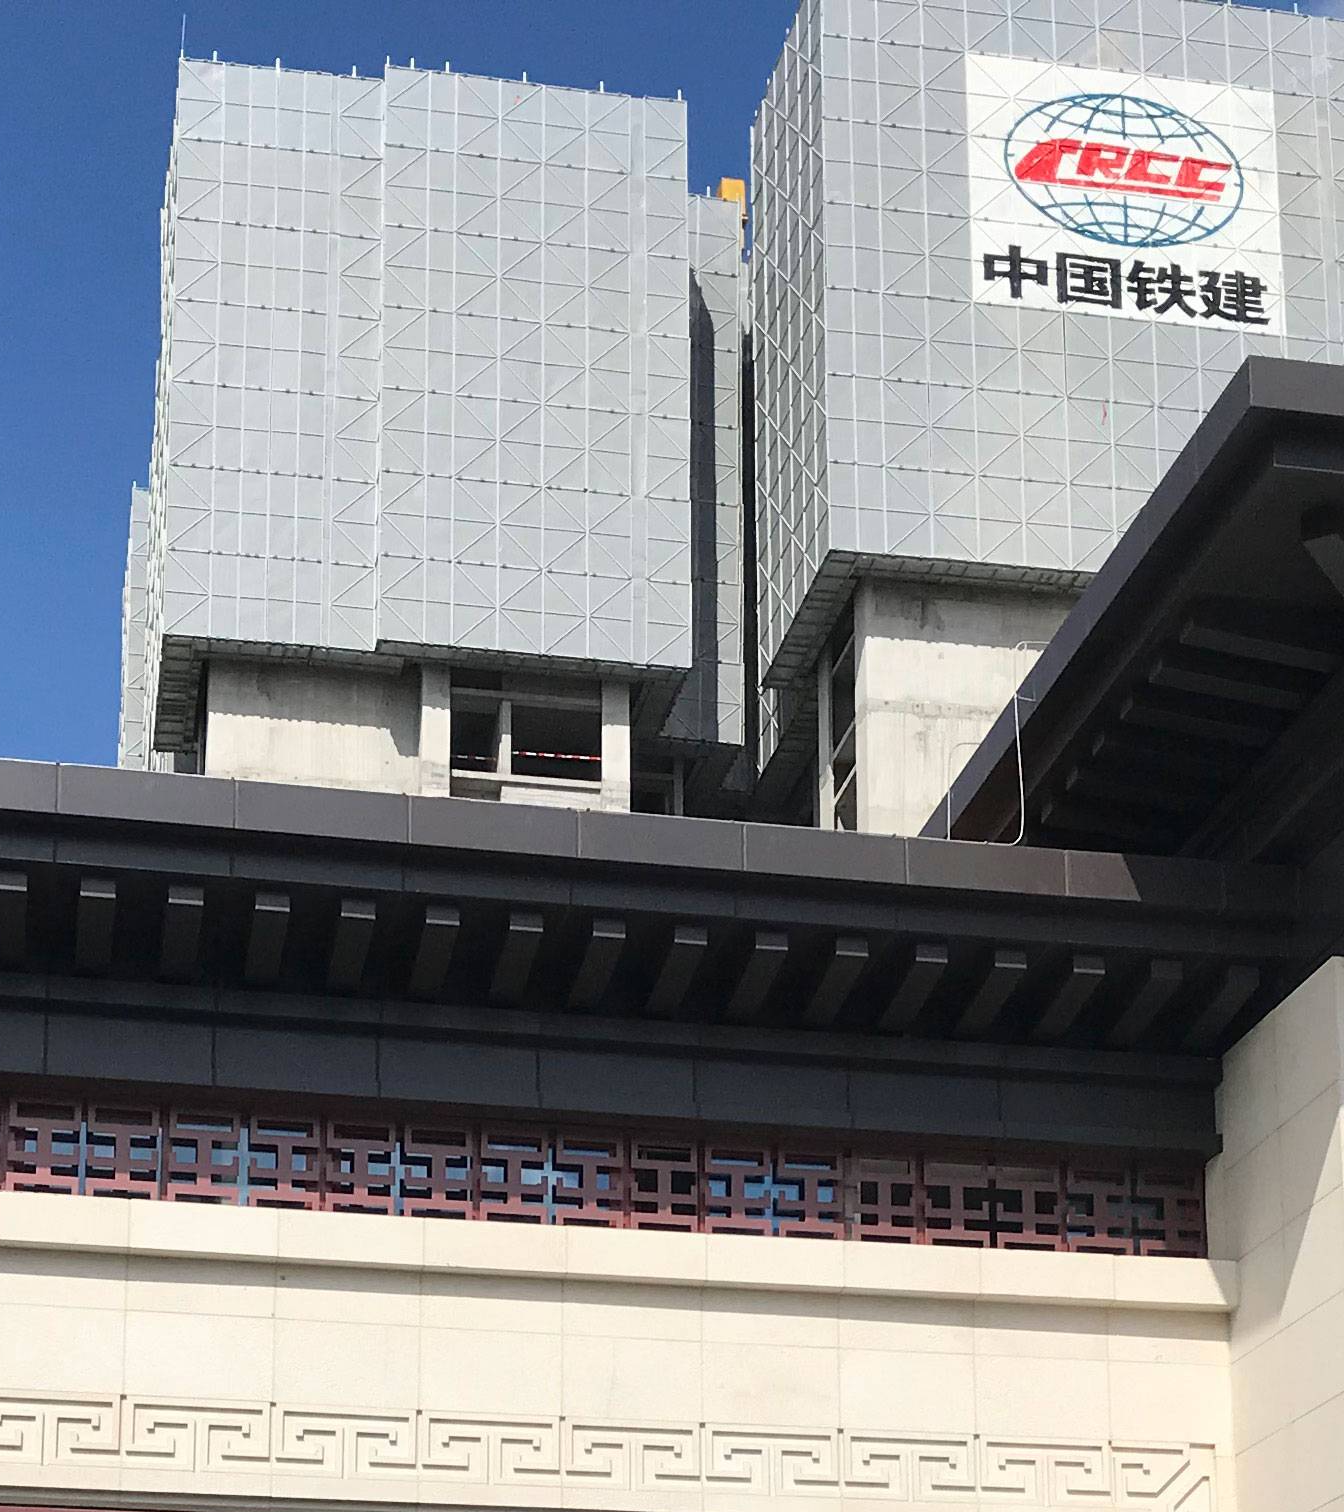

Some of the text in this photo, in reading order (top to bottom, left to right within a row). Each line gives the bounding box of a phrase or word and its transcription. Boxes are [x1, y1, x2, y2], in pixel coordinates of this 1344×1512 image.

[1014, 138, 1232, 202] CRCC
[982, 245, 1271, 325] 中国铁建
